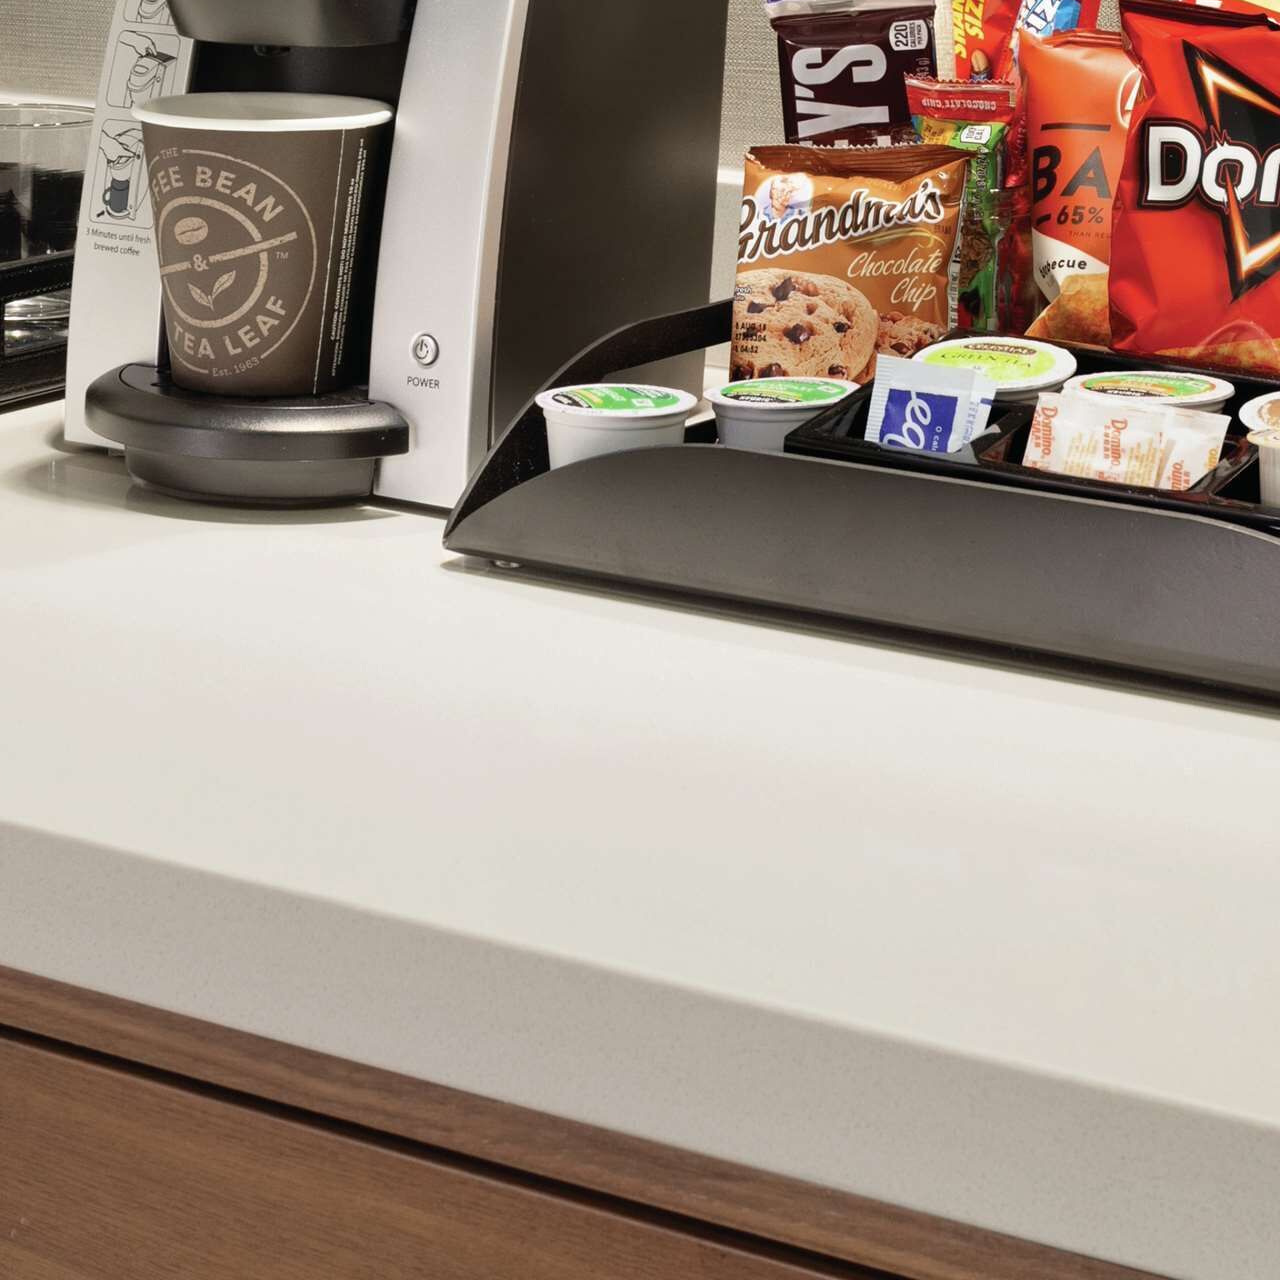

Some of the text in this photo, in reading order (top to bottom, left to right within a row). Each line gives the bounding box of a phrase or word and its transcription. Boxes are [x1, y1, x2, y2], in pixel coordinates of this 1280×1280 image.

[894, 23, 909, 47] 220
[160, 147, 179, 159] THE
[194, 165, 285, 223] BEAN
[738, 180, 942, 262] Grandma's
[1056, 205, 1104, 225] 65%
[86, 227, 152, 245] 3 Minutes until fresh
[93, 241, 140, 257] brewed coffee
[192, 254, 209, 272] &
[847, 248, 943, 278] Chocolate
[890, 277, 937, 312] Chip
[173, 295, 286, 360] TEA LEAF
[212, 356, 260, 377] Est. 1963
[407, 376, 440, 389] POWER
[1041, 406, 1058, 456] Domino
[1111, 418, 1129, 466] Domino
